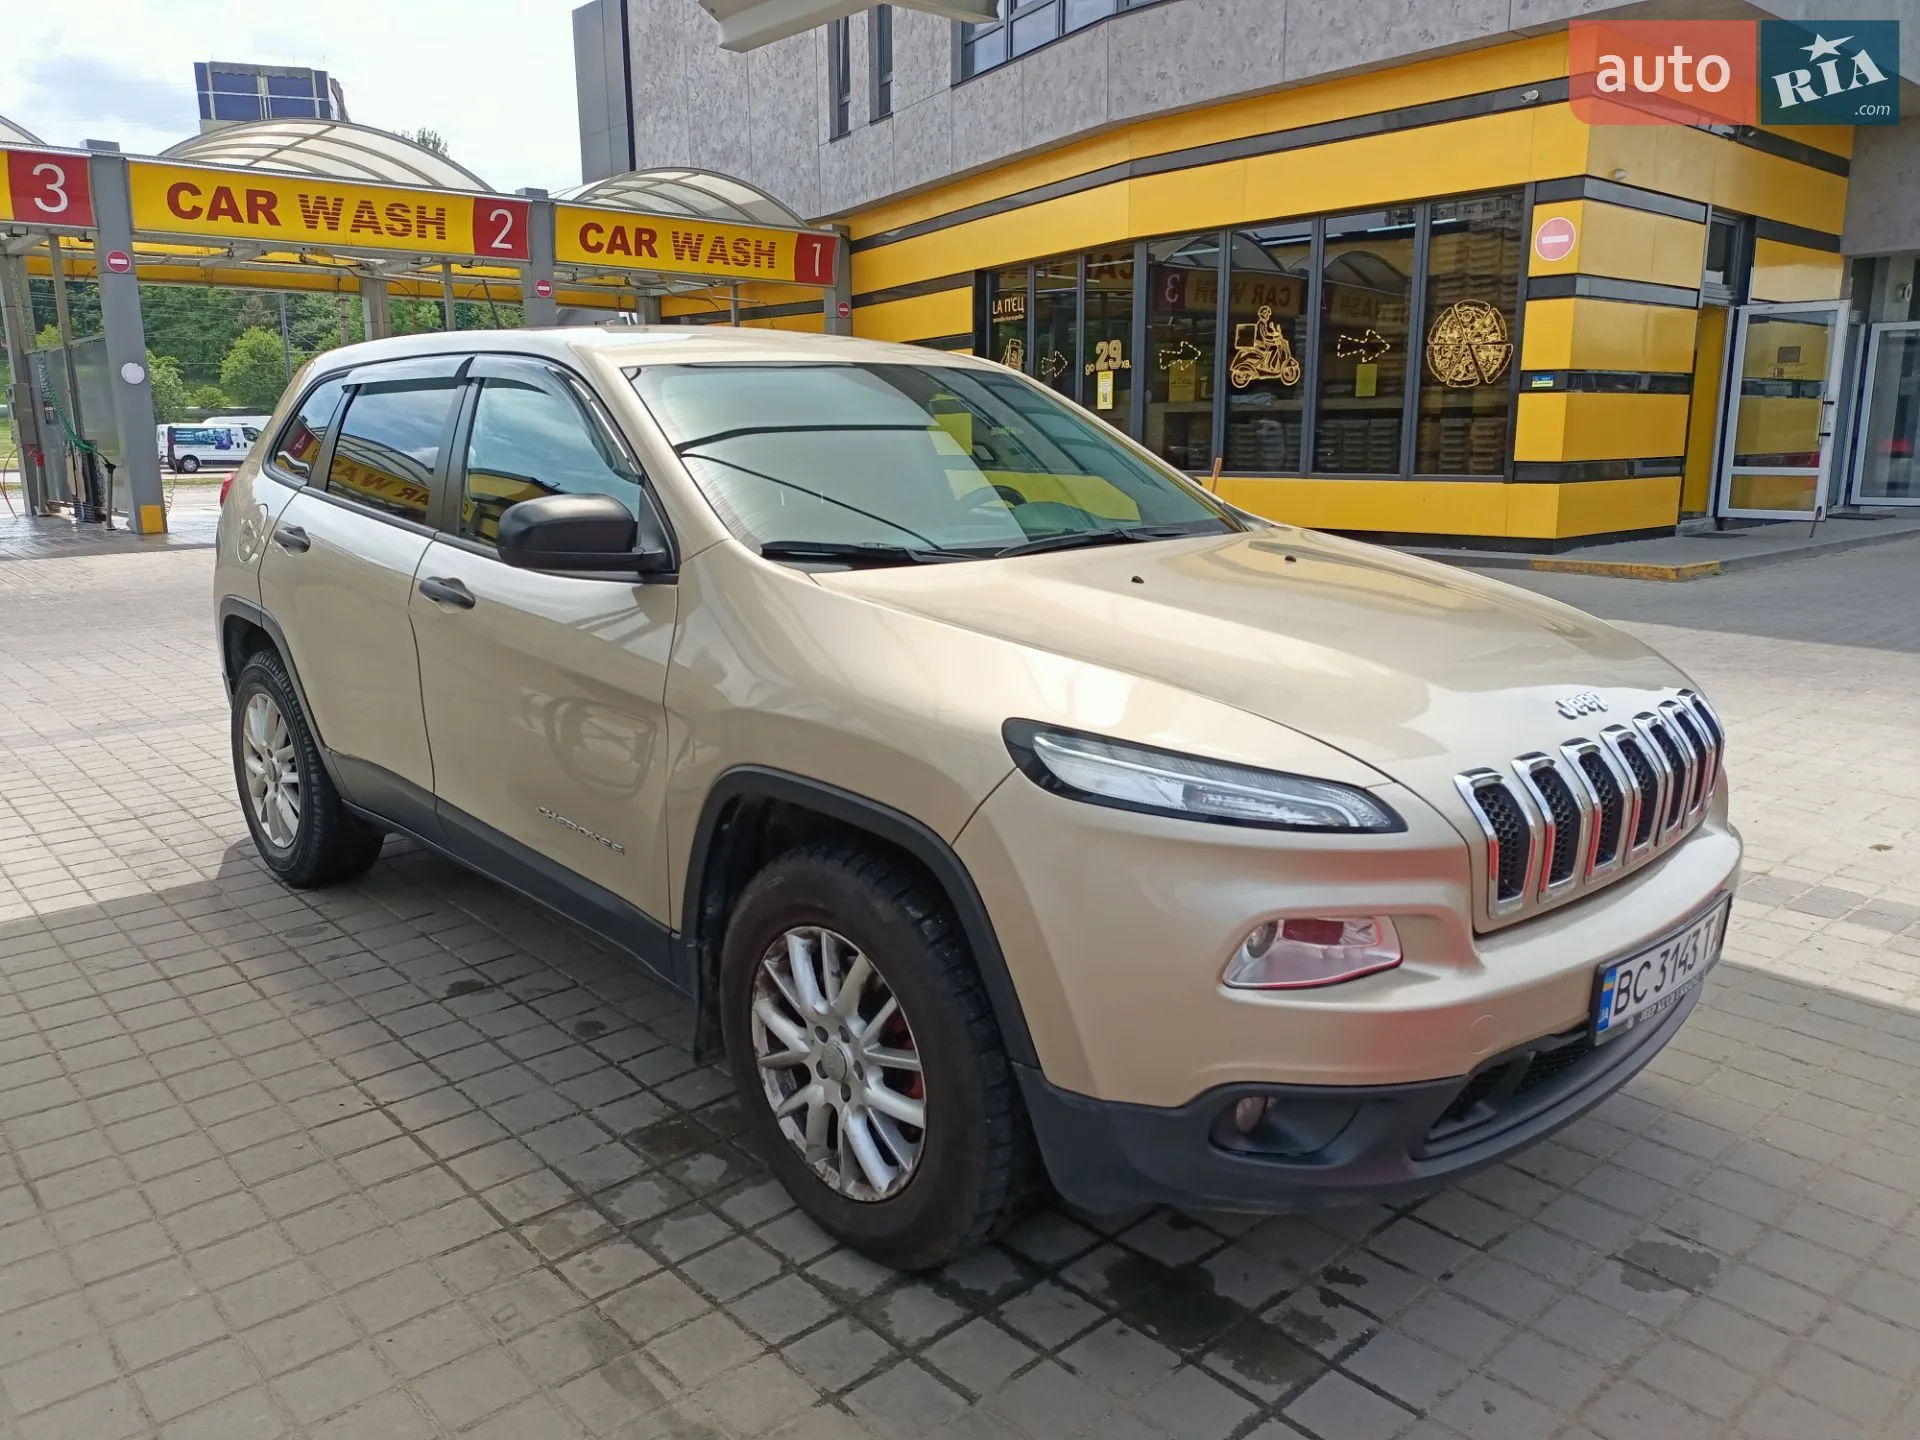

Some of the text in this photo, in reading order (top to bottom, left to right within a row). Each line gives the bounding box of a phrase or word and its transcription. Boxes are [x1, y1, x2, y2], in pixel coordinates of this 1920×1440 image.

[32, 162, 69, 214] 3
[166, 181, 514, 250] CAR WASH 2
[578, 222, 822, 278] CAR WASH 1
[993, 300, 1003, 315] LA
[1095, 339, 1122, 371] 29
[1554, 692, 1609, 720] Jeep
[1614, 960, 1651, 1017] BC
[1654, 927, 1701, 994] 3143
